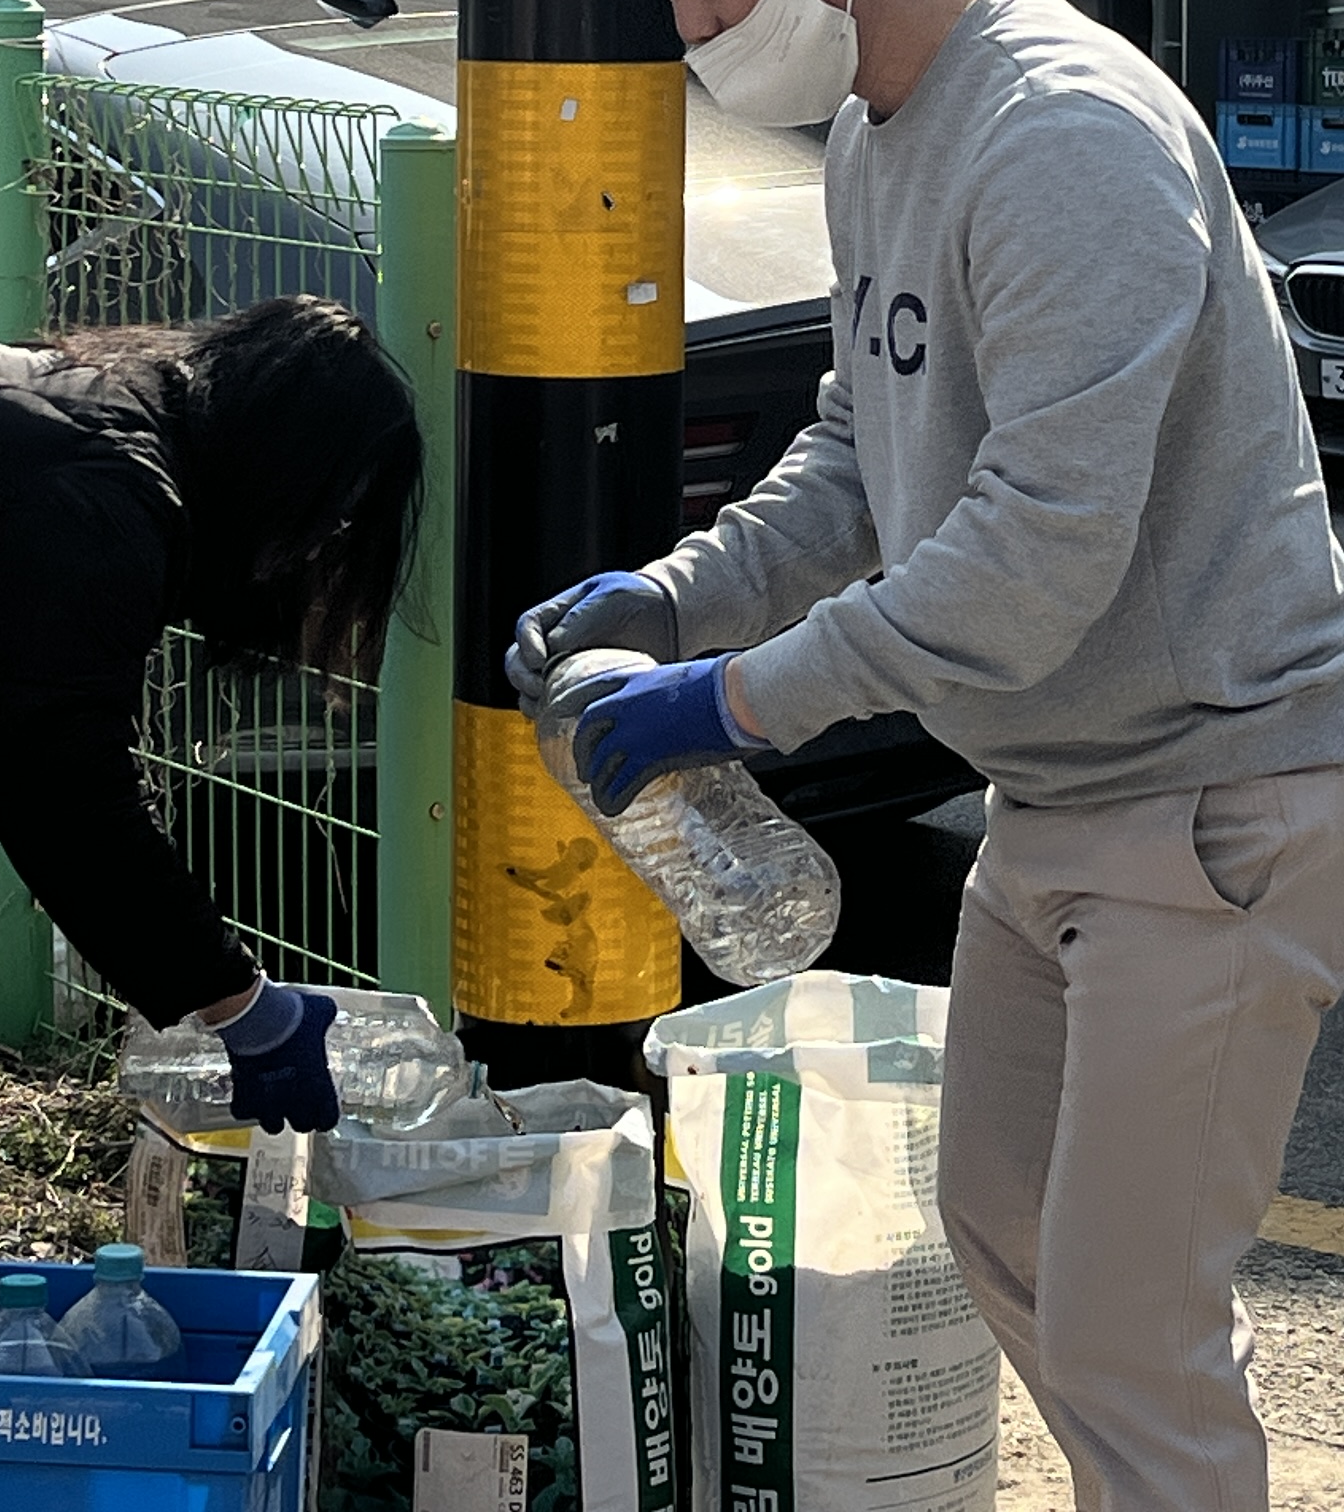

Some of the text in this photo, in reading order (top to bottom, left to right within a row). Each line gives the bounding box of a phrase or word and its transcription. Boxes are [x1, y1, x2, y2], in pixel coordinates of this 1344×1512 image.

[739, 1215, 778, 1296] gold
[628, 1231, 671, 1487] 배양토 gold
[731, 1308, 779, 1465] 배양토
[508, 1466, 524, 1496] 463
